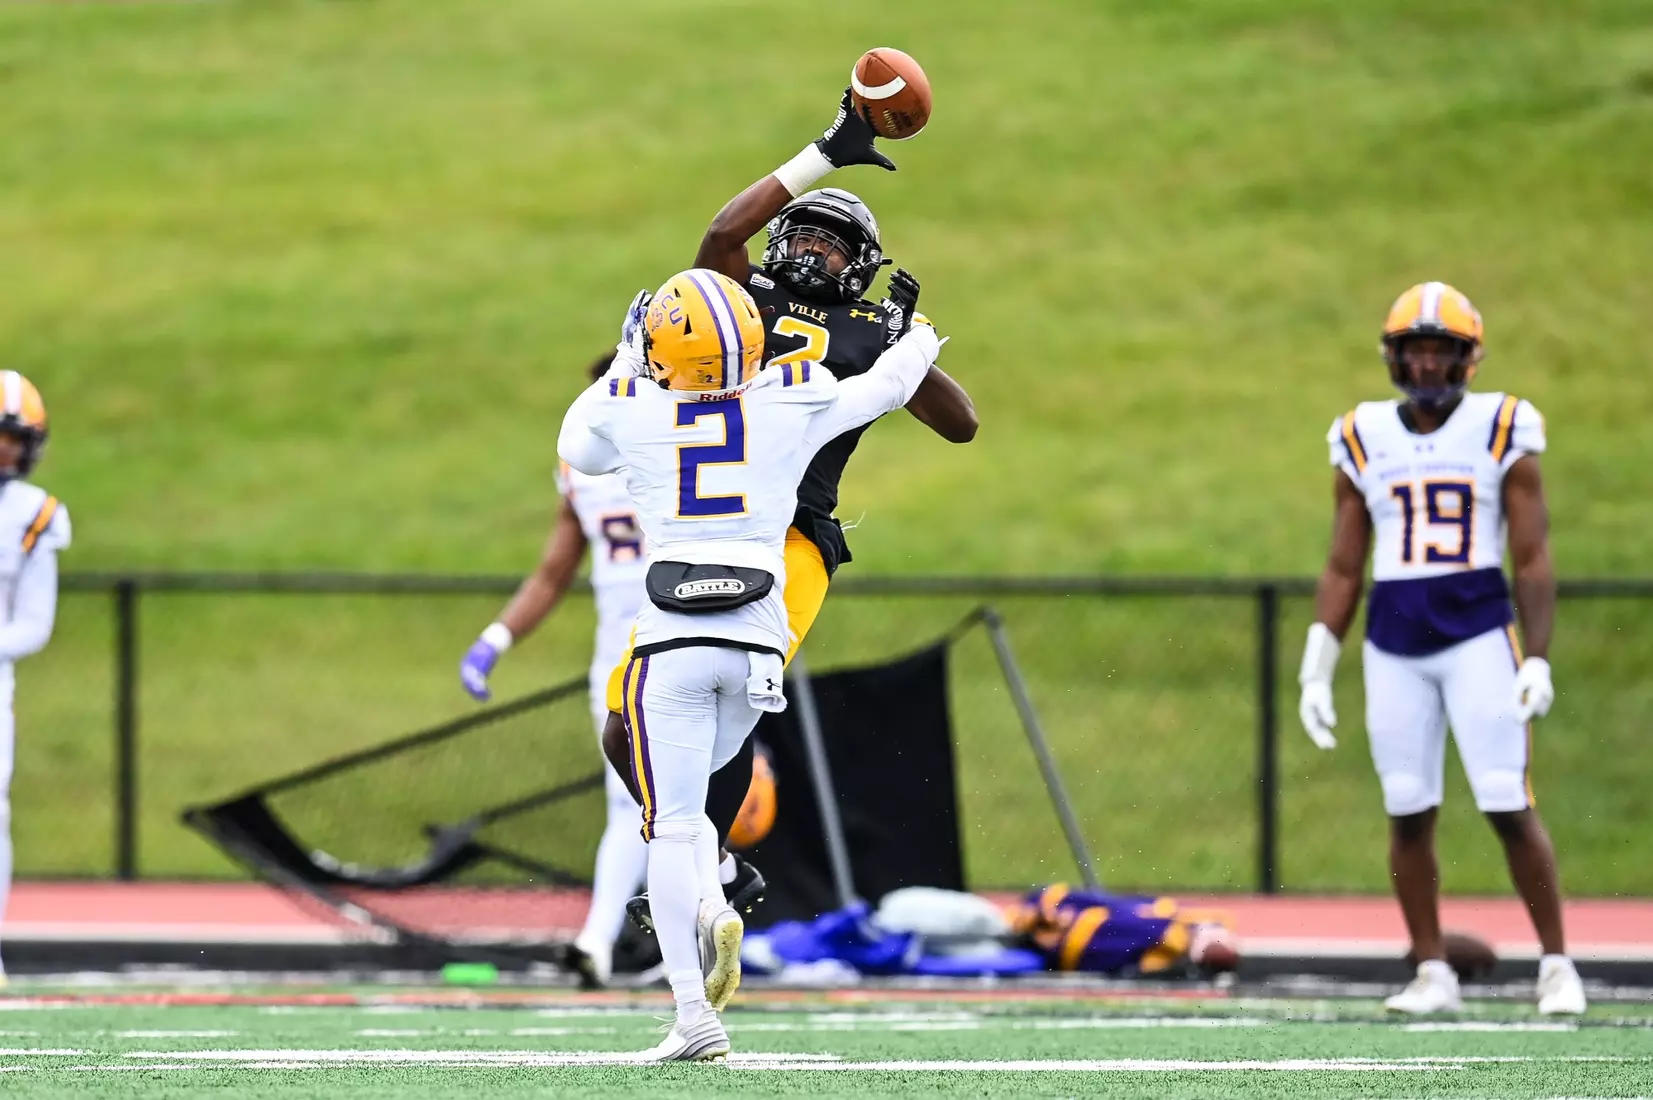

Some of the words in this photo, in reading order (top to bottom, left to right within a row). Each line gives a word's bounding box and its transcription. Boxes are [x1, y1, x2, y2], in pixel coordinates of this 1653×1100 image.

[788, 302, 828, 324] VILLE
[765, 315, 830, 368] 2
[673, 397, 748, 519] 2
[1388, 477, 1475, 567] 19
[680, 582, 740, 596] BATTLE
